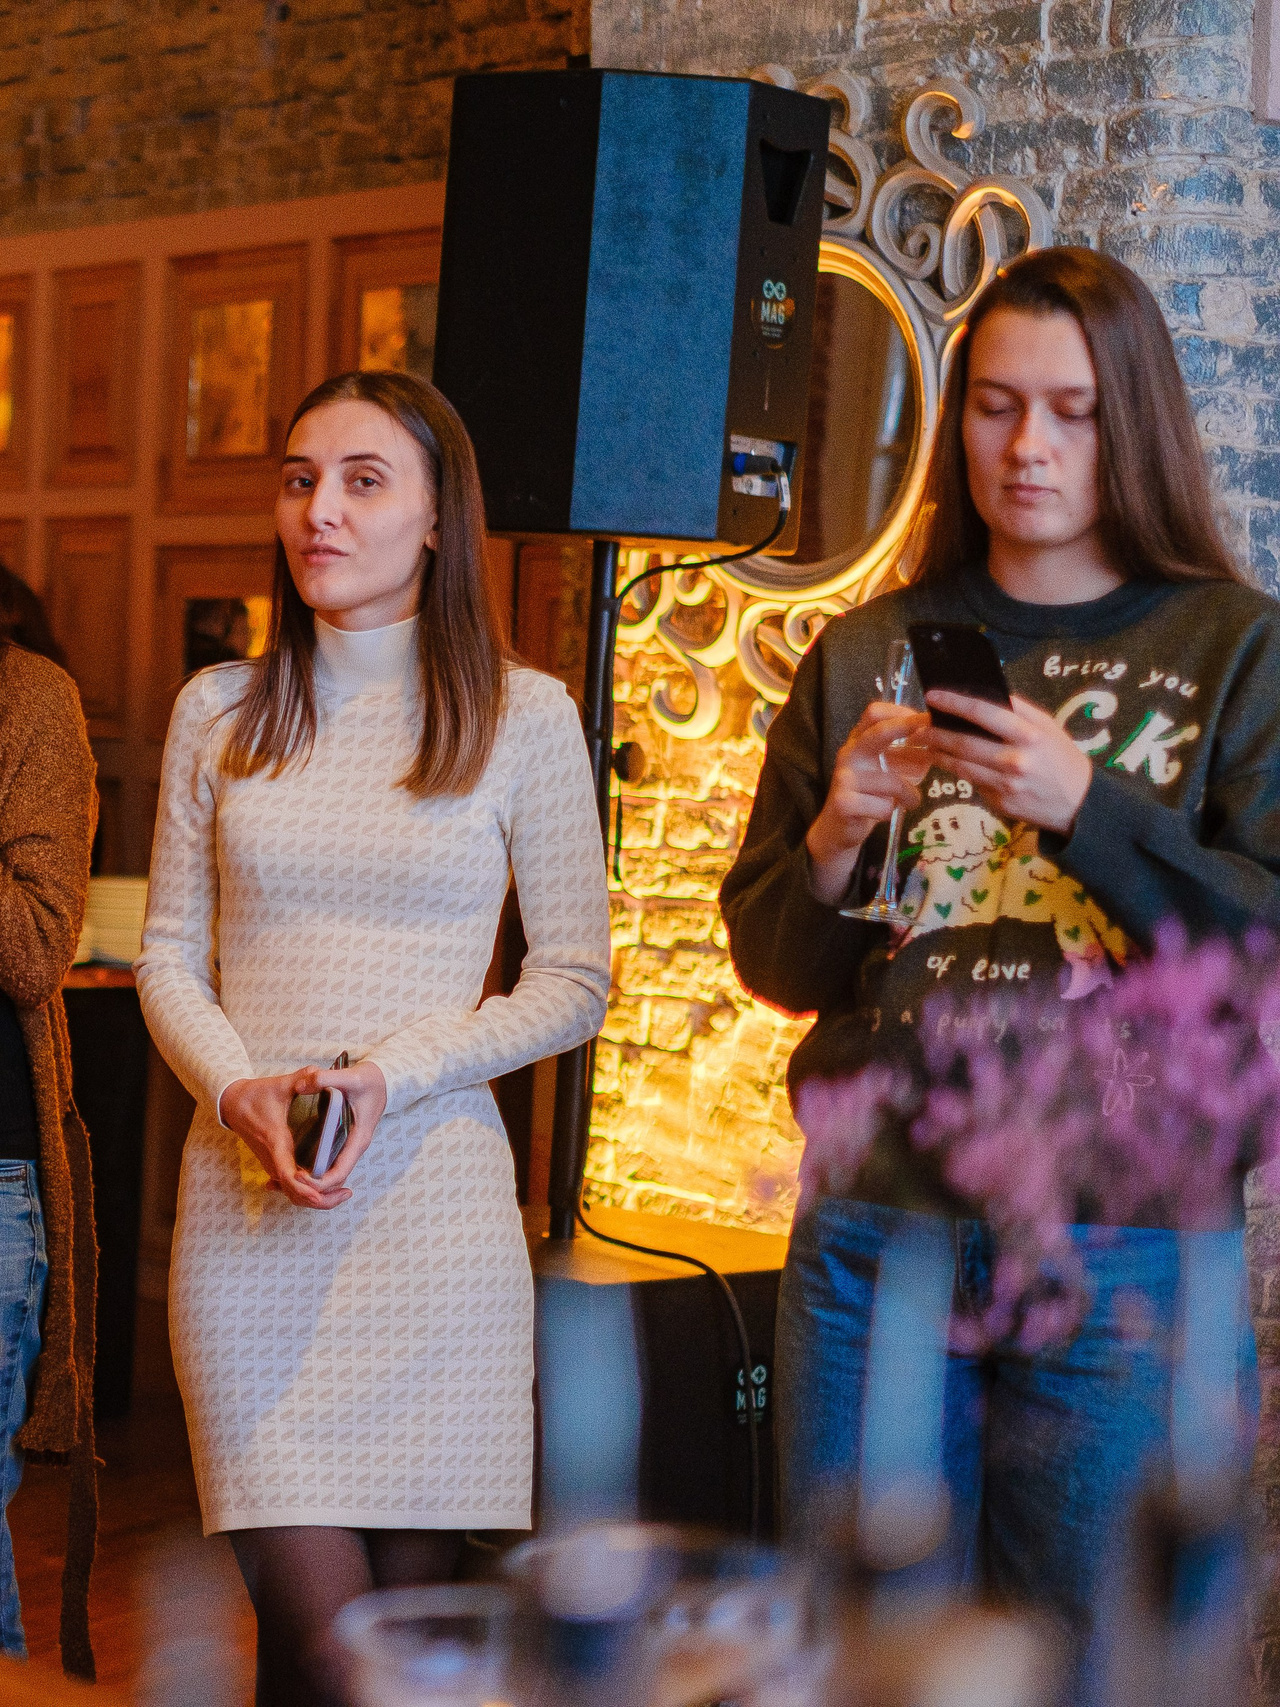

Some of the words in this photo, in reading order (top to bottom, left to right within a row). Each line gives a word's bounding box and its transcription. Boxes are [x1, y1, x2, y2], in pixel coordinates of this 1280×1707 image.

[1043, 655, 1128, 680] bring
[1138, 667, 1200, 697] you
[927, 779, 973, 798] dog
[926, 955, 956, 978] of
[971, 958, 1031, 981] love
